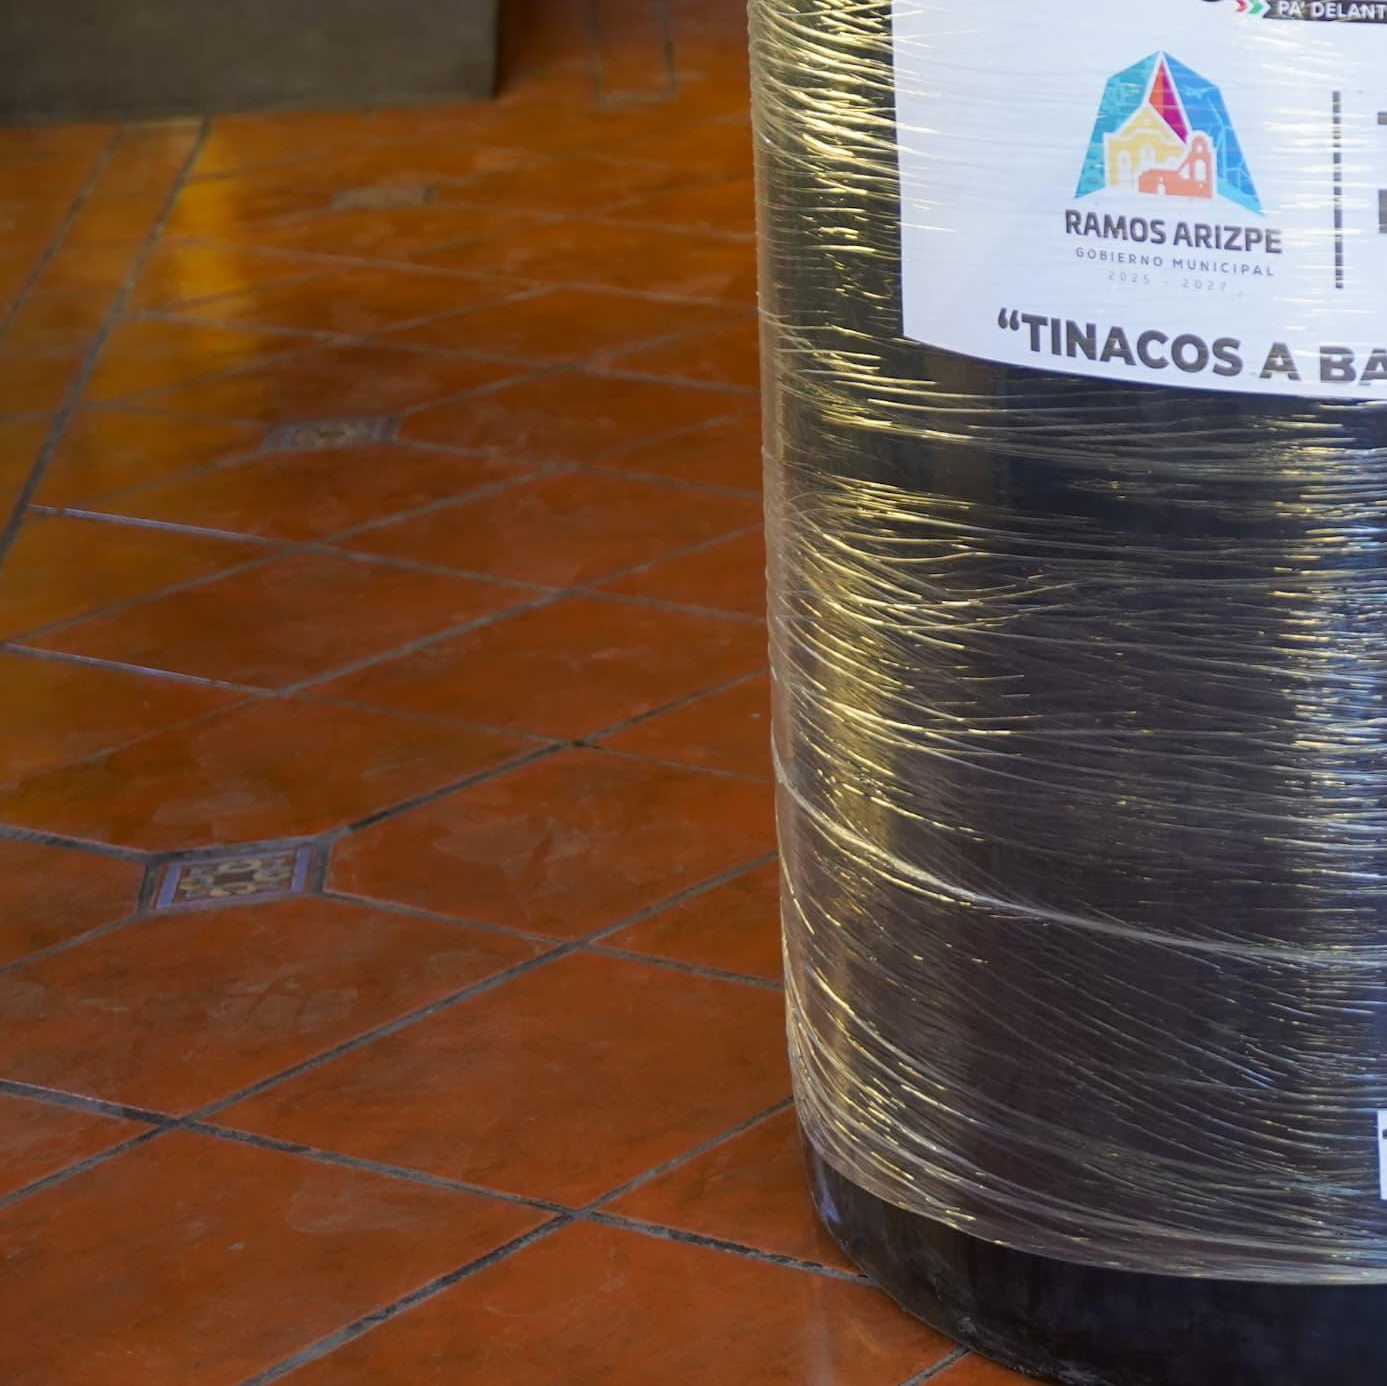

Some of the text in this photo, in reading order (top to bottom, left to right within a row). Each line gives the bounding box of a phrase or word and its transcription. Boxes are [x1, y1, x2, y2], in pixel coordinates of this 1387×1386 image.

[1065, 209, 1283, 254] RAMOS ARIZPE
[1075, 247, 1275, 277] GOBIERNO MUNICIPAL
[1108, 270, 1151, 285] 2025
[997, 307, 1244, 378] “TINACOS
[1258, 342, 1302, 381] A
